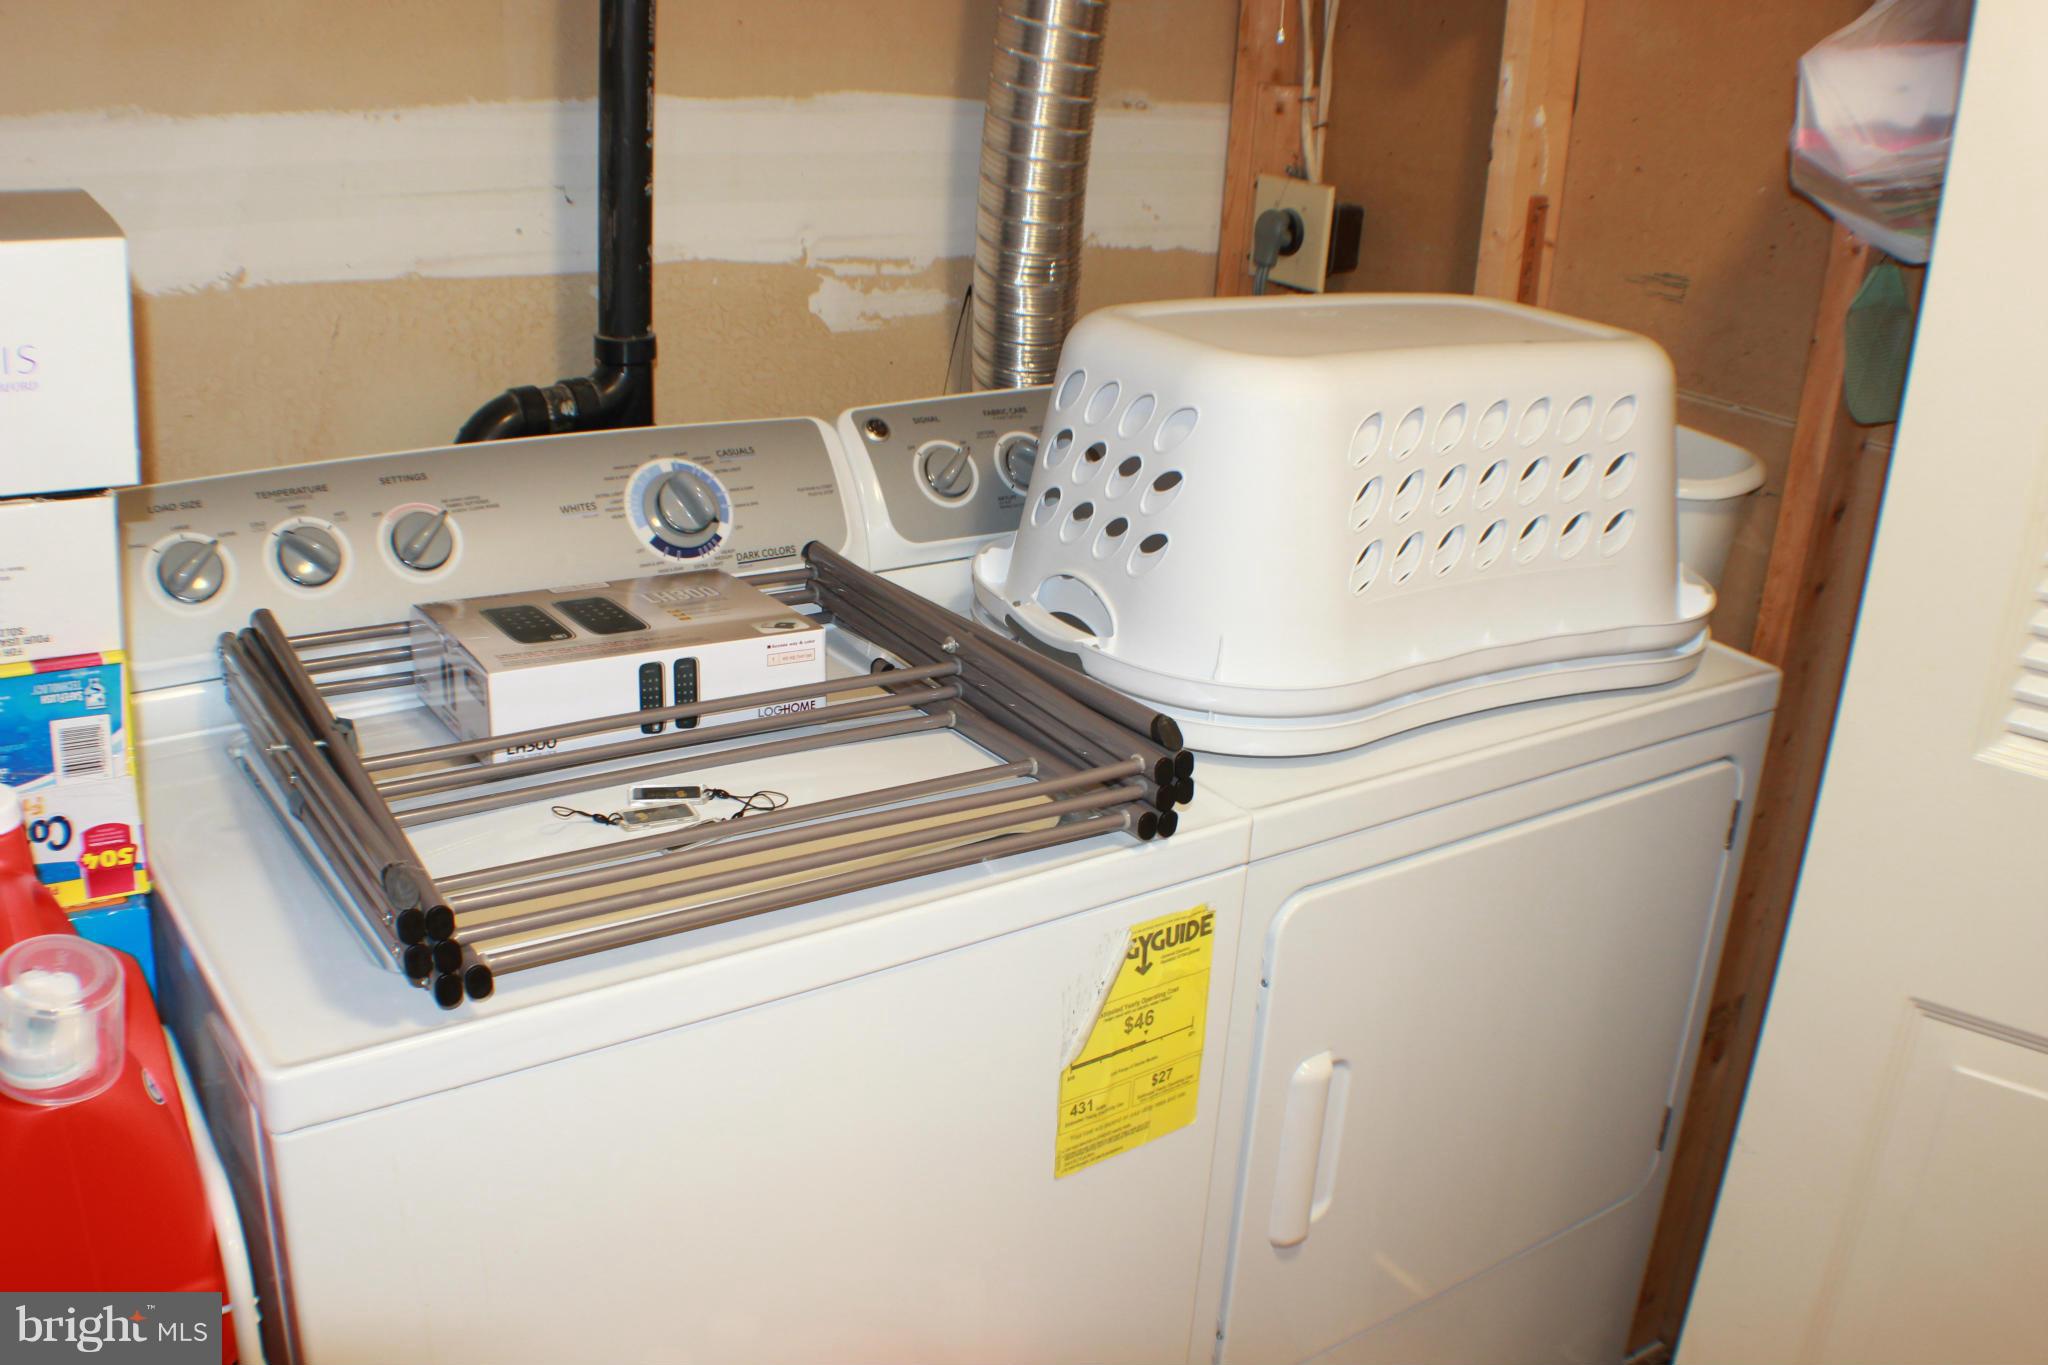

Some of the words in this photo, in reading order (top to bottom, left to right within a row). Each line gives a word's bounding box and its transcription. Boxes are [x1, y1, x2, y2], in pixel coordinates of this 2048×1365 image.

[912, 415, 941, 425] SIGNAL
[716, 446, 755, 457] CASUALS
[379, 472, 428, 486] SETTINGS
[255, 483, 329, 499] TEMPERATURE
[147, 503, 177, 514] LOAD
[178, 499, 204, 510] SIZE
[559, 502, 598, 516] WHITES
[736, 550, 760, 562] DARK
[761, 545, 797, 557] COLORS
[641, 585, 720, 604] LH300
[758, 700, 816, 718] LOGHOME
[28, 815, 72, 851] Co
[82, 847, 134, 870] 504
[1124, 1009, 1154, 1035] $46
[1151, 1067, 1173, 1087] $27
[1070, 1098, 1094, 1117] 431
